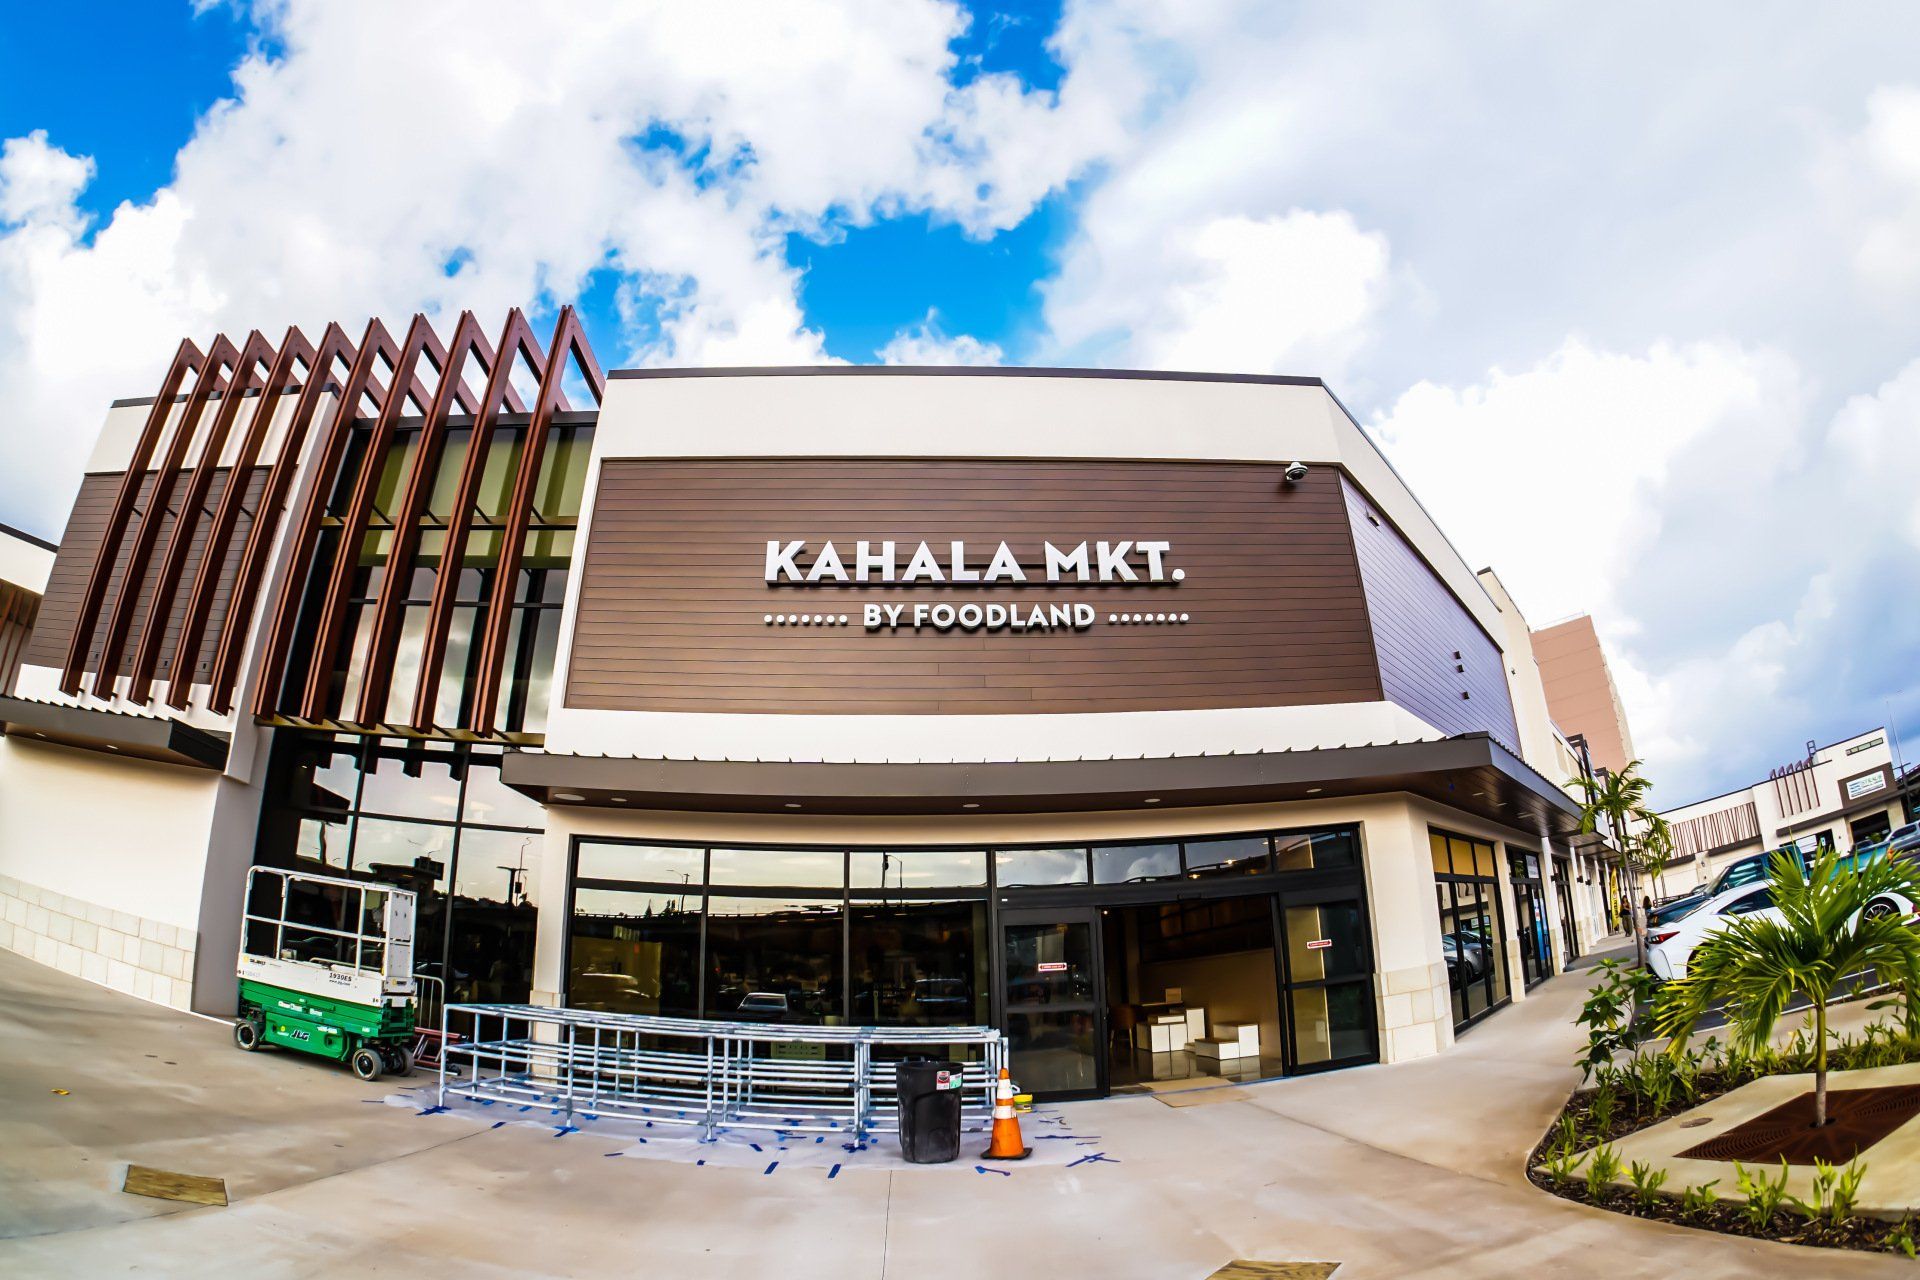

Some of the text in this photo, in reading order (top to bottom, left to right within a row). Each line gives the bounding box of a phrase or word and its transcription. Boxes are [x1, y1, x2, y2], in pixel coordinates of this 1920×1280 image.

[764, 540, 1186, 583] KAHALA MKT.
[863, 603, 1095, 629] BY FOODLAND
[291, 1030, 310, 1042] JLG
